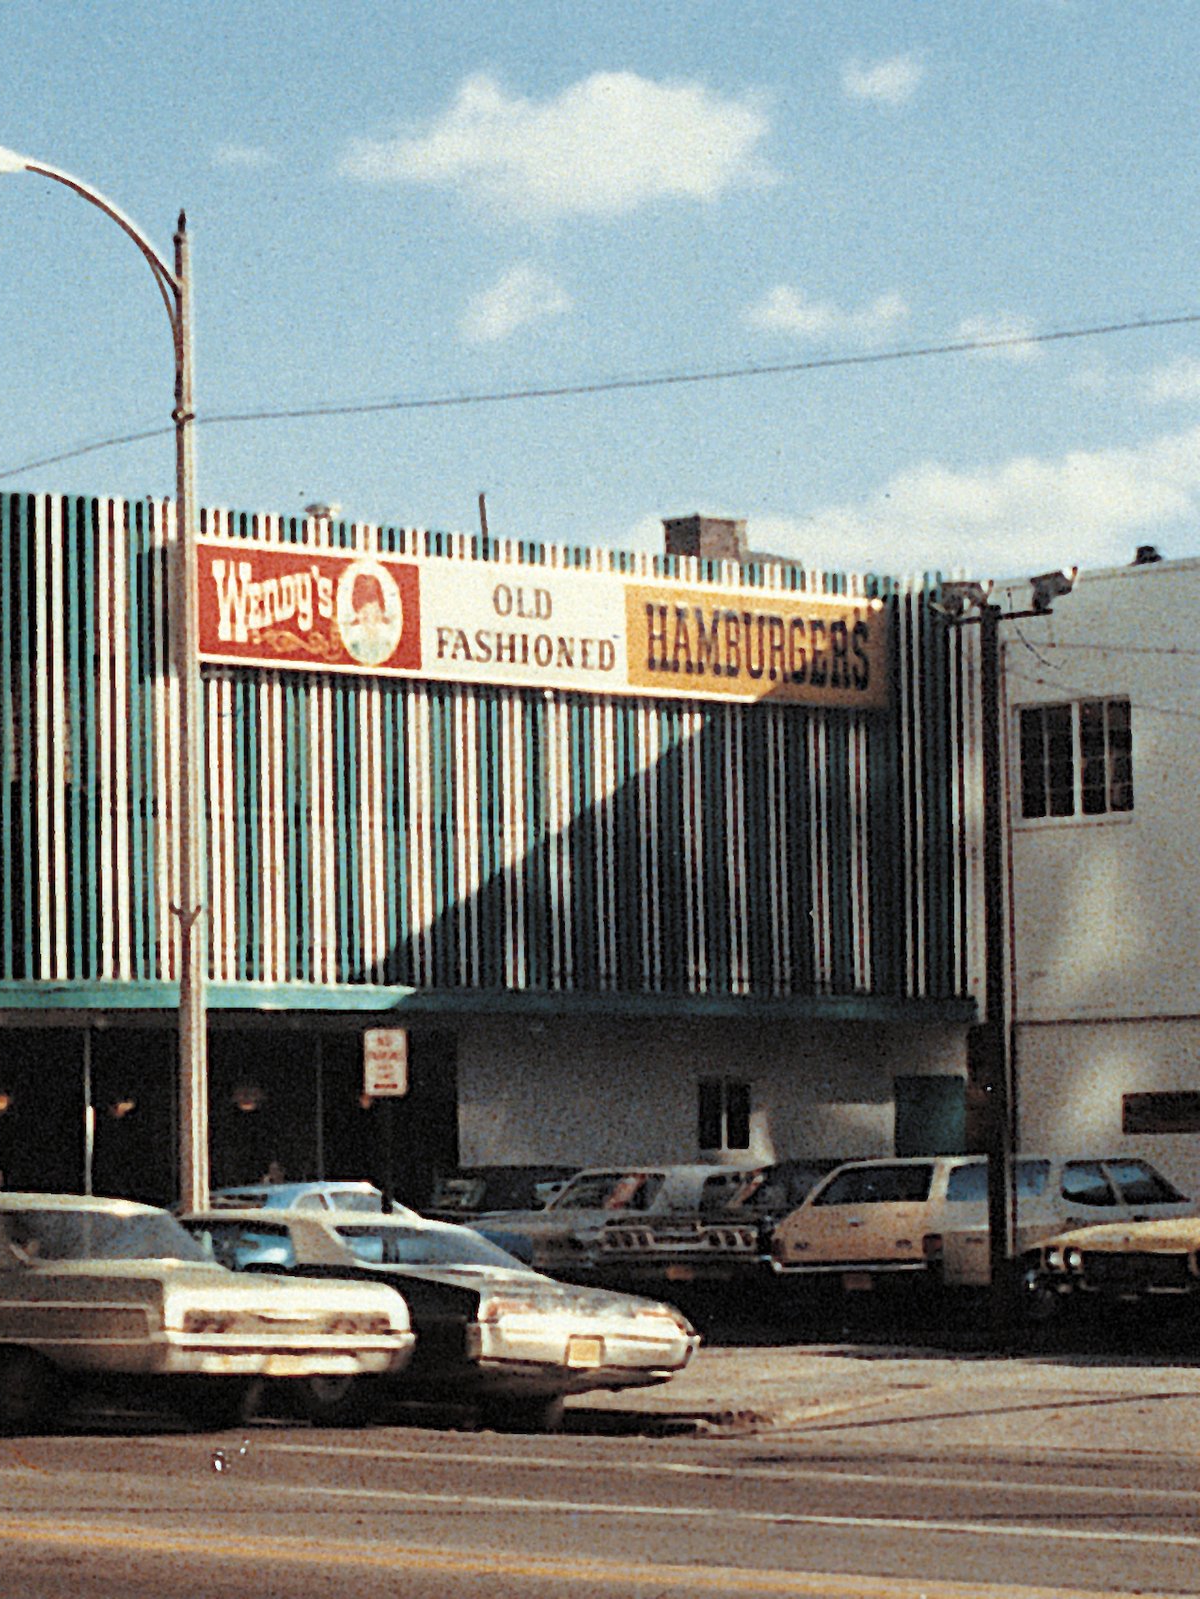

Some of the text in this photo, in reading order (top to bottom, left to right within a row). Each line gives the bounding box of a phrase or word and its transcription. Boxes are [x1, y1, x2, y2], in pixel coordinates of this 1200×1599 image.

[493, 583, 553, 620] OLD
[436, 626, 616, 672] FASHIONED
[645, 602, 871, 691] HAMBURGERS
